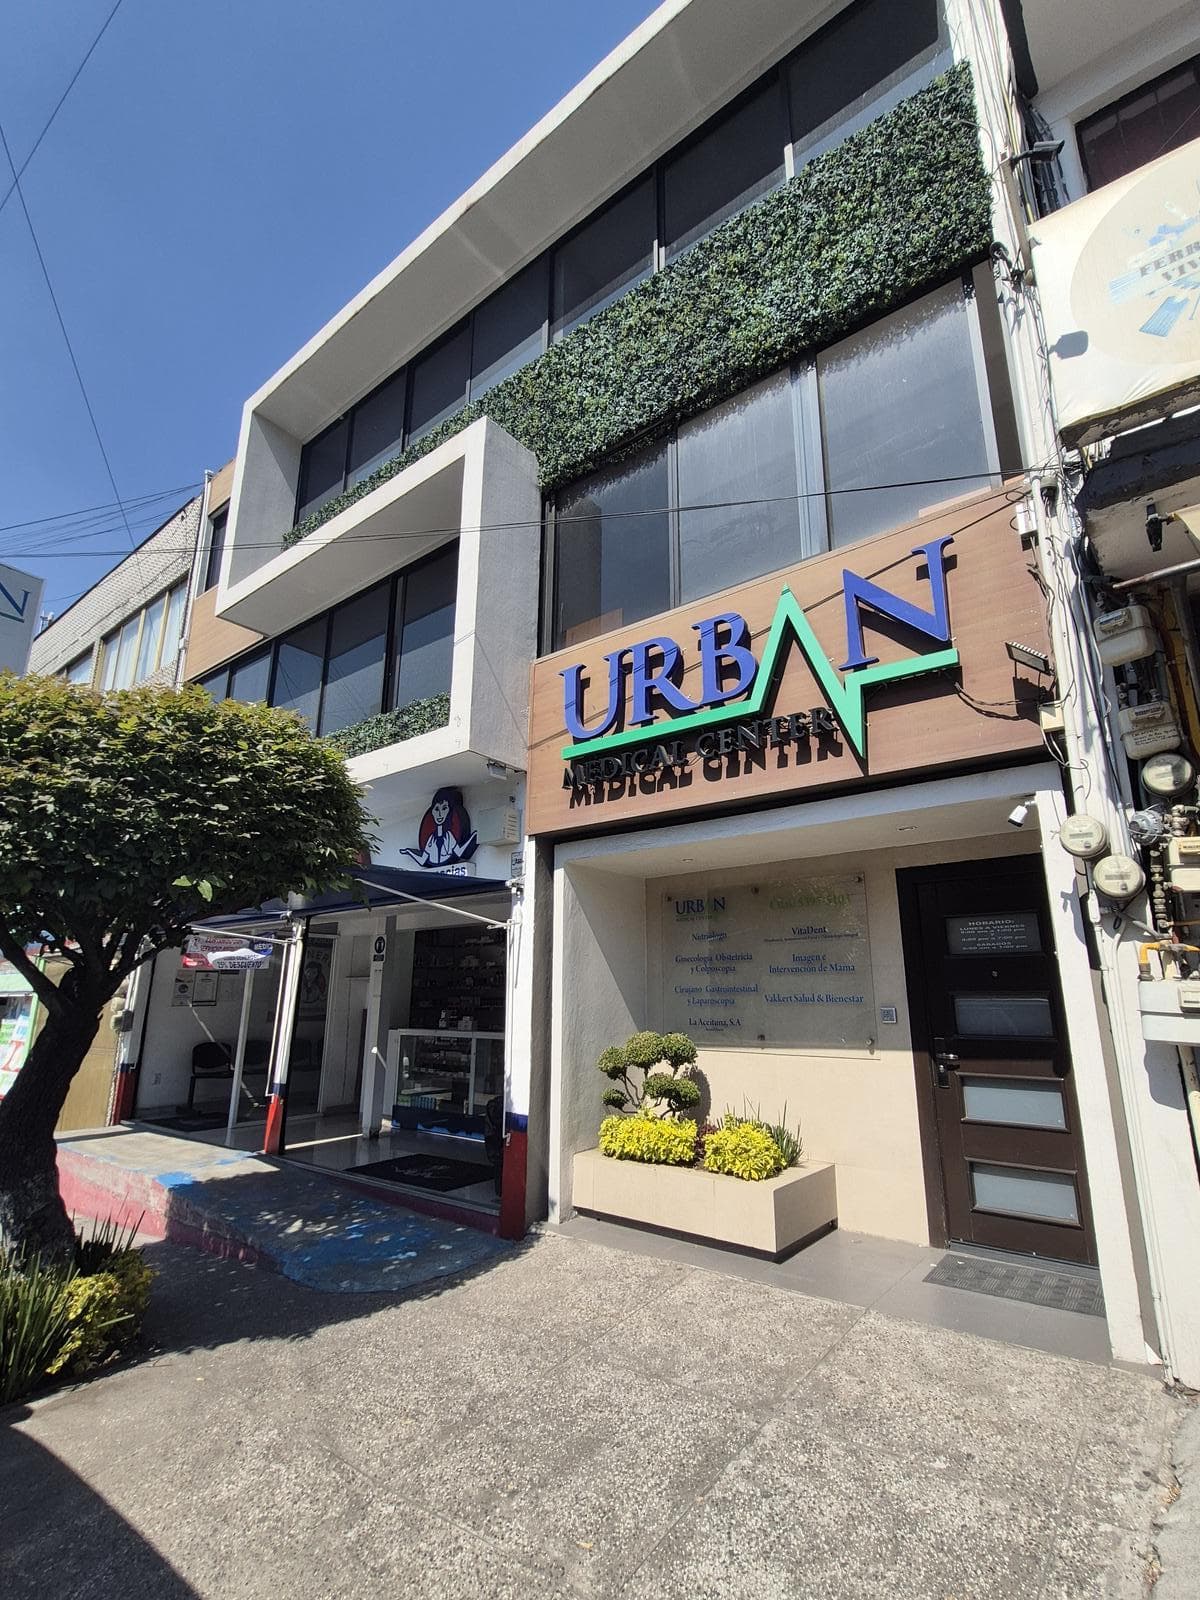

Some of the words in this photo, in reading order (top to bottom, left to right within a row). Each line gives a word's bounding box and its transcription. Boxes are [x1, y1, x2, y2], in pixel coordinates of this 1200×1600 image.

[1161, 257, 1200, 280] VIV
[559, 534, 955, 741] URBAN
[562, 739, 689, 790] MEDICAL
[695, 706, 841, 760] CENTER
[675, 895, 726, 915] URBAN
[791, 926, 827, 936] VitaDent
[792, 953, 820, 964] Imagen
[818, 963, 827, 972] de
[793, 993, 815, 1003] Salud
[816, 993, 824, 1003] &
[825, 993, 865, 1003] Bienestar
